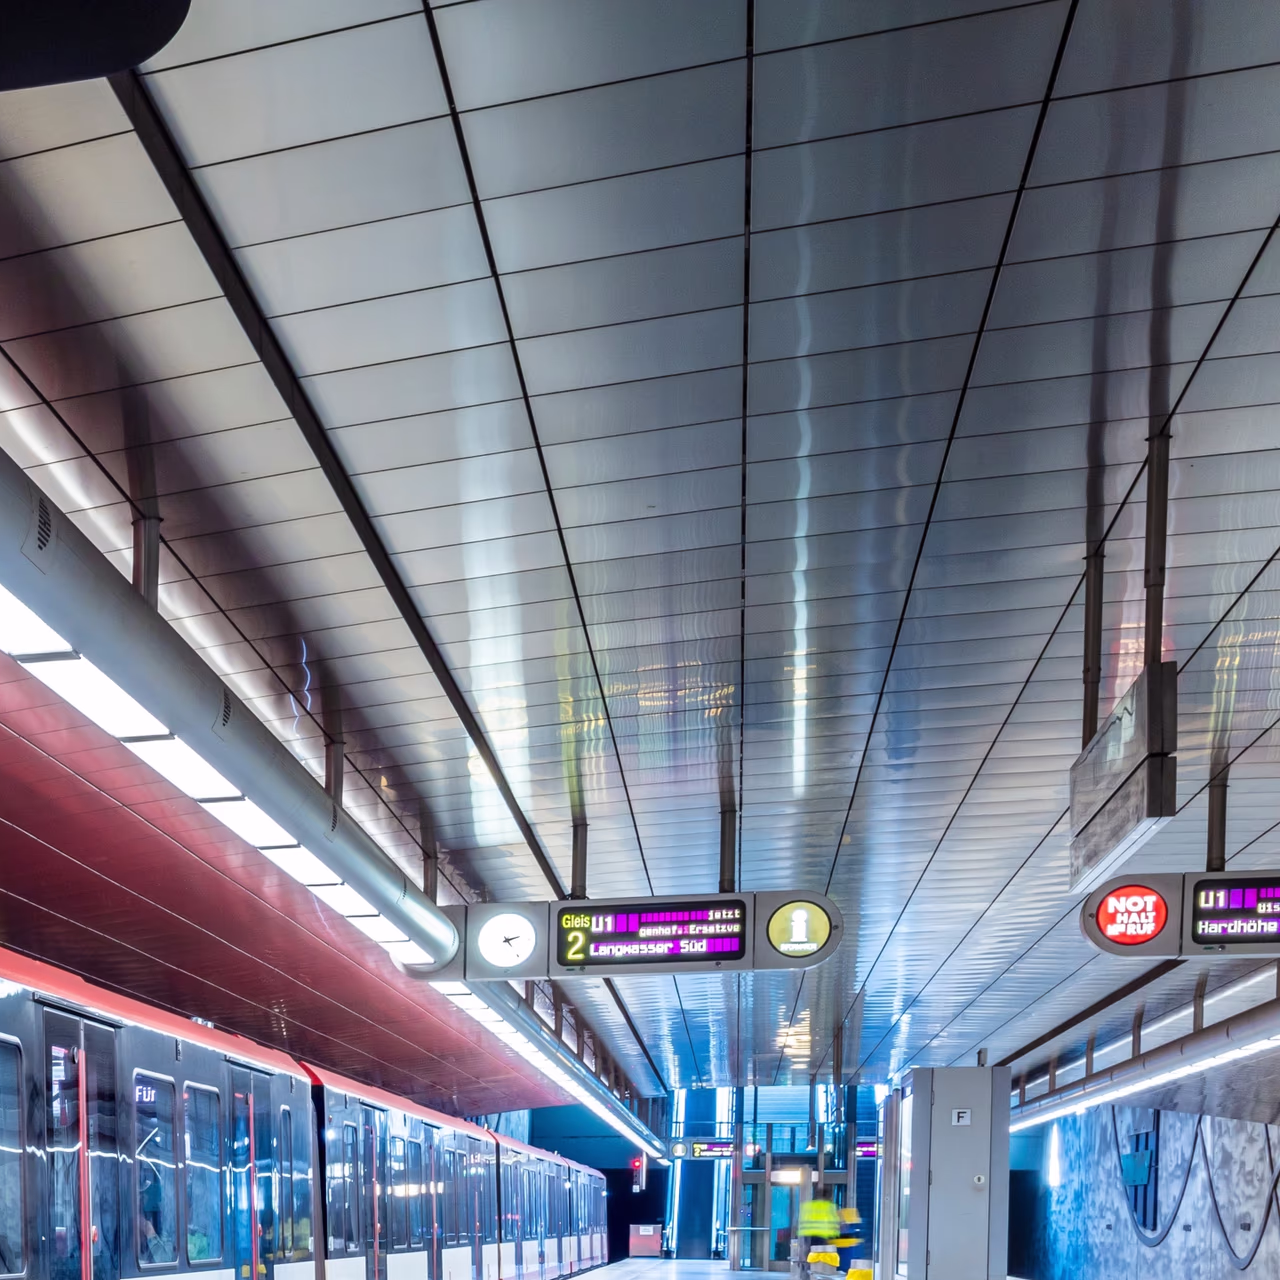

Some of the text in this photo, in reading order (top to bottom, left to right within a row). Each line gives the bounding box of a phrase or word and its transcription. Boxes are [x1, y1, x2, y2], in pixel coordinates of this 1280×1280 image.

[1108, 895, 1156, 913] NOT
[1199, 890, 1225, 909] U1
[562, 909, 741, 934] Gleis U1 jetzt
[1116, 912, 1156, 924] HALT
[1197, 918, 1278, 935] Hardhöhe
[1126, 923, 1155, 935] RUF
[567, 930, 707, 961] 2 Langwasser Süd
[135, 1085, 156, 1102] Für
[957, 1111, 967, 1124] F
